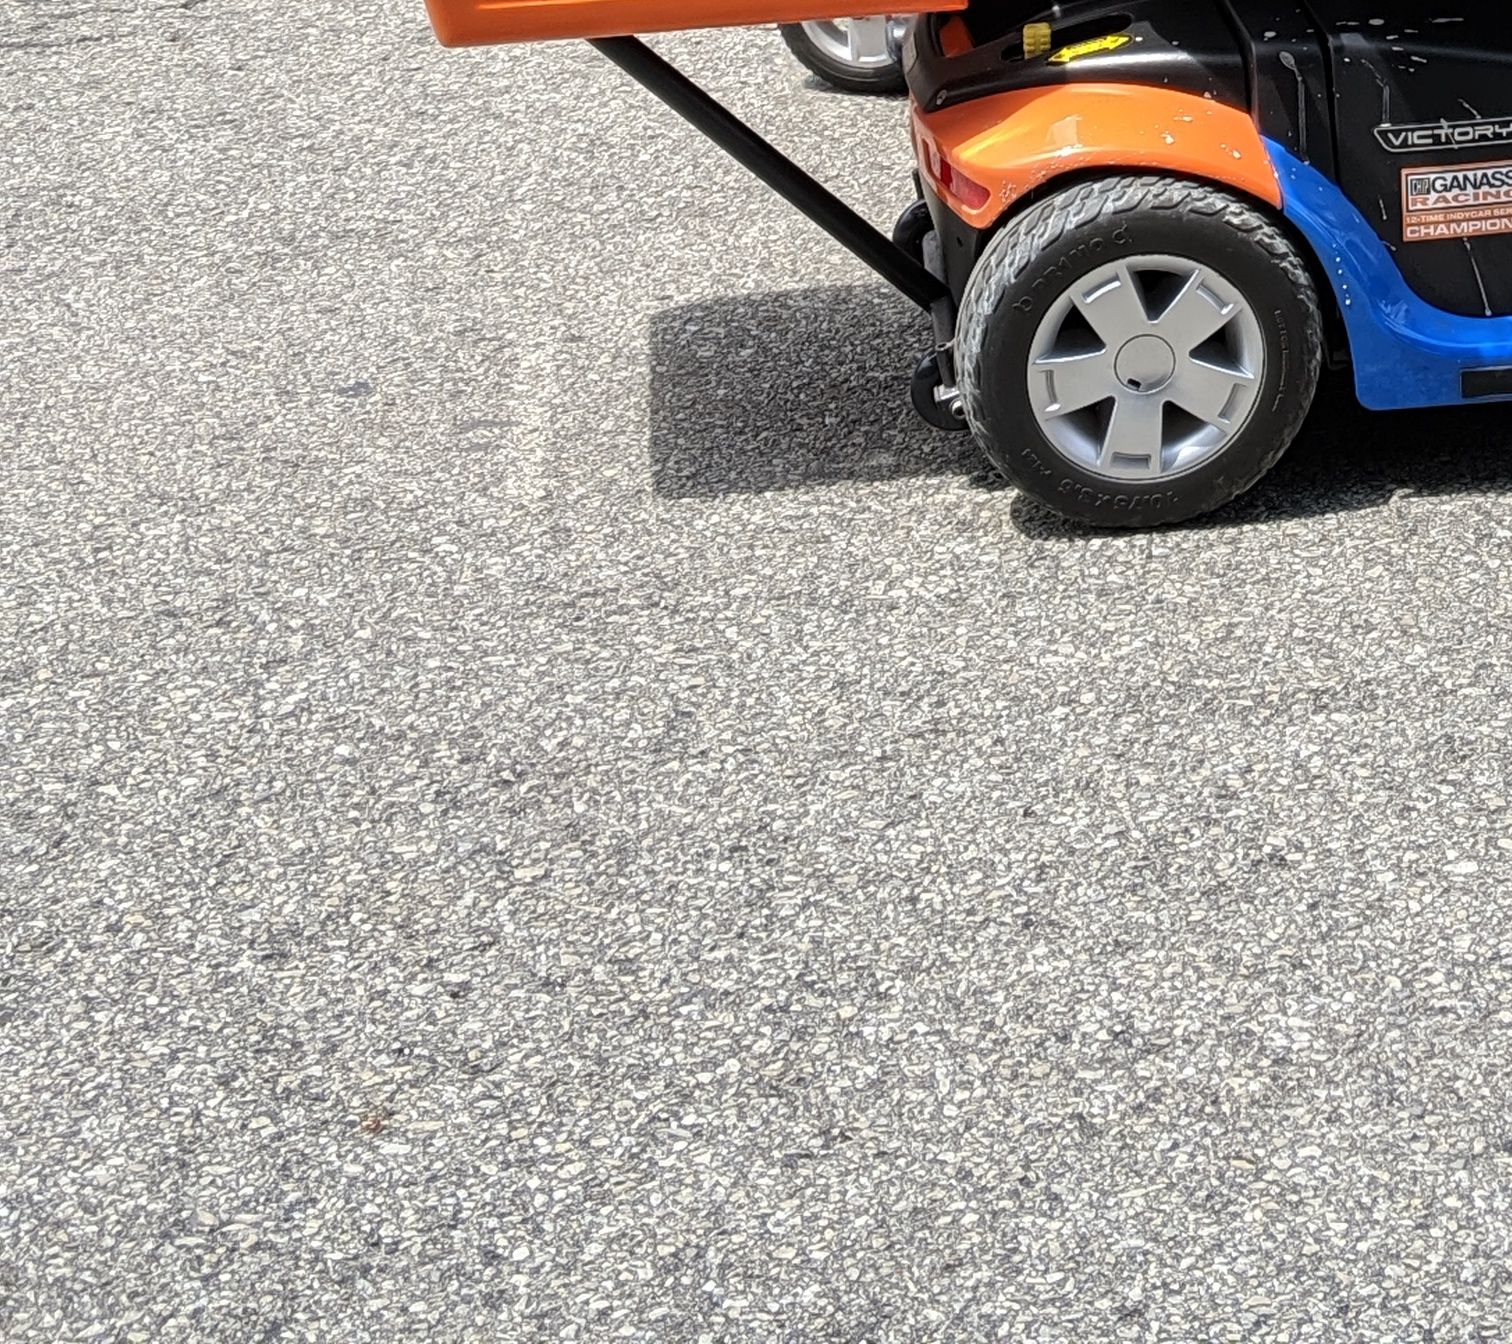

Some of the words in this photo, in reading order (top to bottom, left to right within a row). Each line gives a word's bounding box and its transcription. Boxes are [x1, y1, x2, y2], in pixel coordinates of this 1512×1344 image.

[1412, 178, 1430, 194] CHIP
[1406, 213, 1444, 225] 12-TIME
[1445, 209, 1492, 221] INDYCAR
